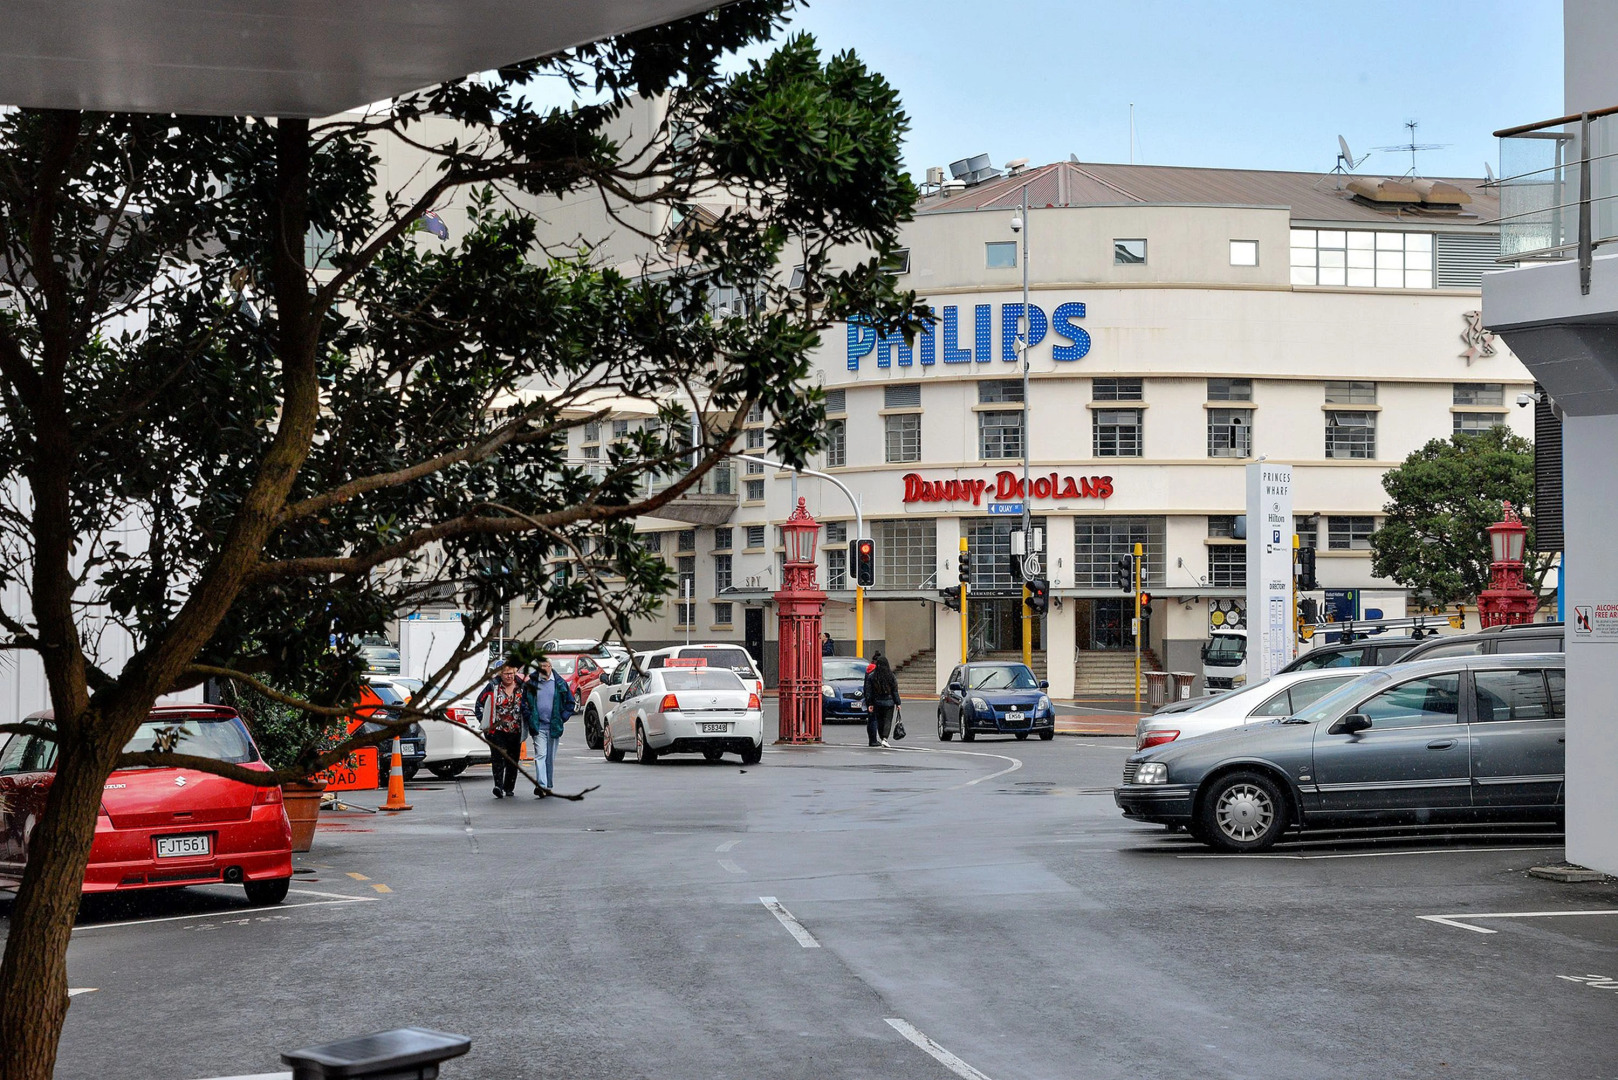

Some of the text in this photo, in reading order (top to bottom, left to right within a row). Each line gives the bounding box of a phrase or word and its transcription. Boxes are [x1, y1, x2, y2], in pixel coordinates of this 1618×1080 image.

[848, 302, 1091, 370] PHILIPS
[1263, 472, 1291, 483] PRINCES
[1266, 486, 1288, 496] WHARF
[999, 505, 1013, 513] QUAY
[1268, 513, 1285, 523] Hilton
[745, 576, 761, 587] SPY
[159, 838, 206, 853] FJT561
